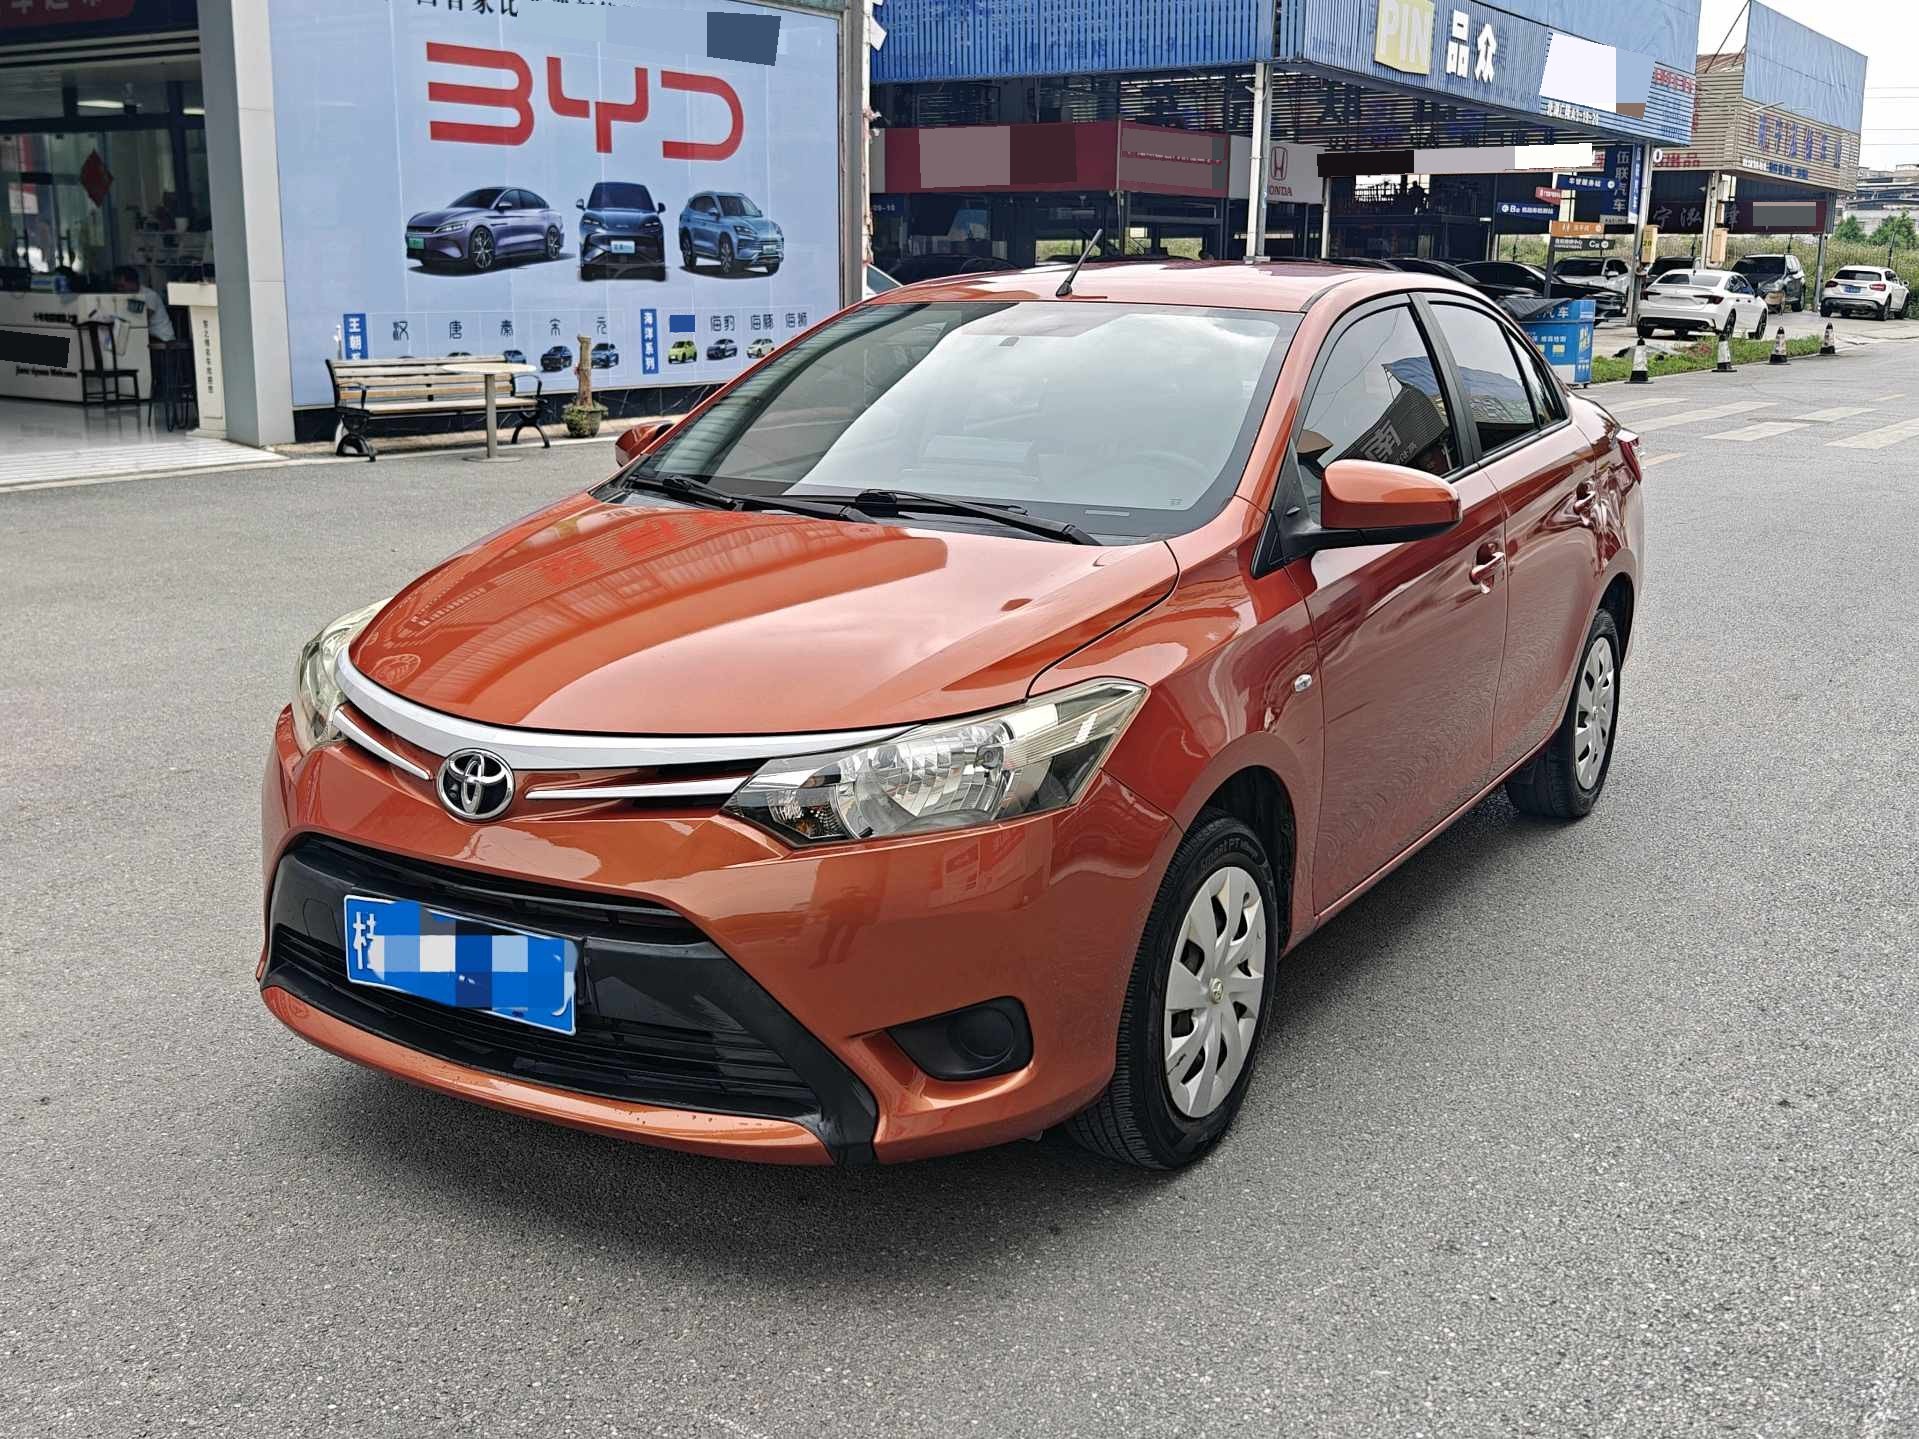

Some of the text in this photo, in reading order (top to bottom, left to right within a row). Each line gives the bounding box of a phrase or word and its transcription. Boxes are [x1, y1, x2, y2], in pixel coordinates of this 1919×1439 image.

[1379, 0, 1430, 66] PIN
[1446, 9, 1497, 84] 品众
[426, 41, 745, 161] BYD
[1270, 185, 1293, 197] ONDA
[449, 320, 463, 340] 唐
[500, 319, 514, 337] 秦
[596, 316, 608, 336] 元
